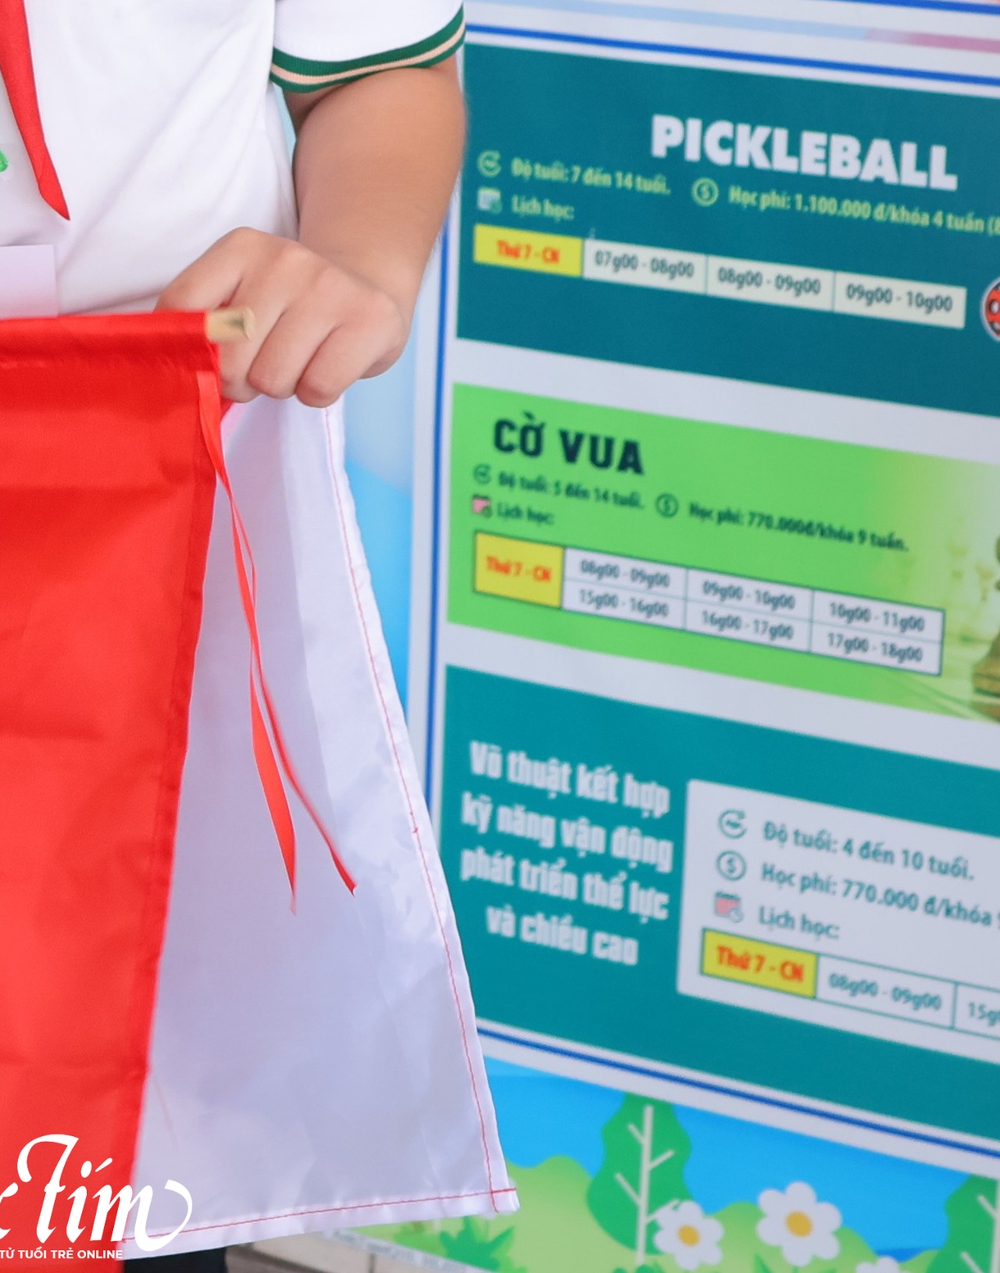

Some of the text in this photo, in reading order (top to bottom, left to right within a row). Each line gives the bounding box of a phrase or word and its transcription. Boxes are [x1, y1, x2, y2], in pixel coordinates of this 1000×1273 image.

[651, 114, 958, 192] PICKLEBALL
[495, 412, 644, 475] CỜ VUA
[470, 740, 669, 819] Võ thuật kết hợp
[461, 792, 673, 874] kỹ năng vận động
[461, 849, 669, 923] phát triển thể lực
[761, 863, 991, 927] Học phí: 770.000 đ/khóa
[486, 906, 639, 966] và chiều cao
